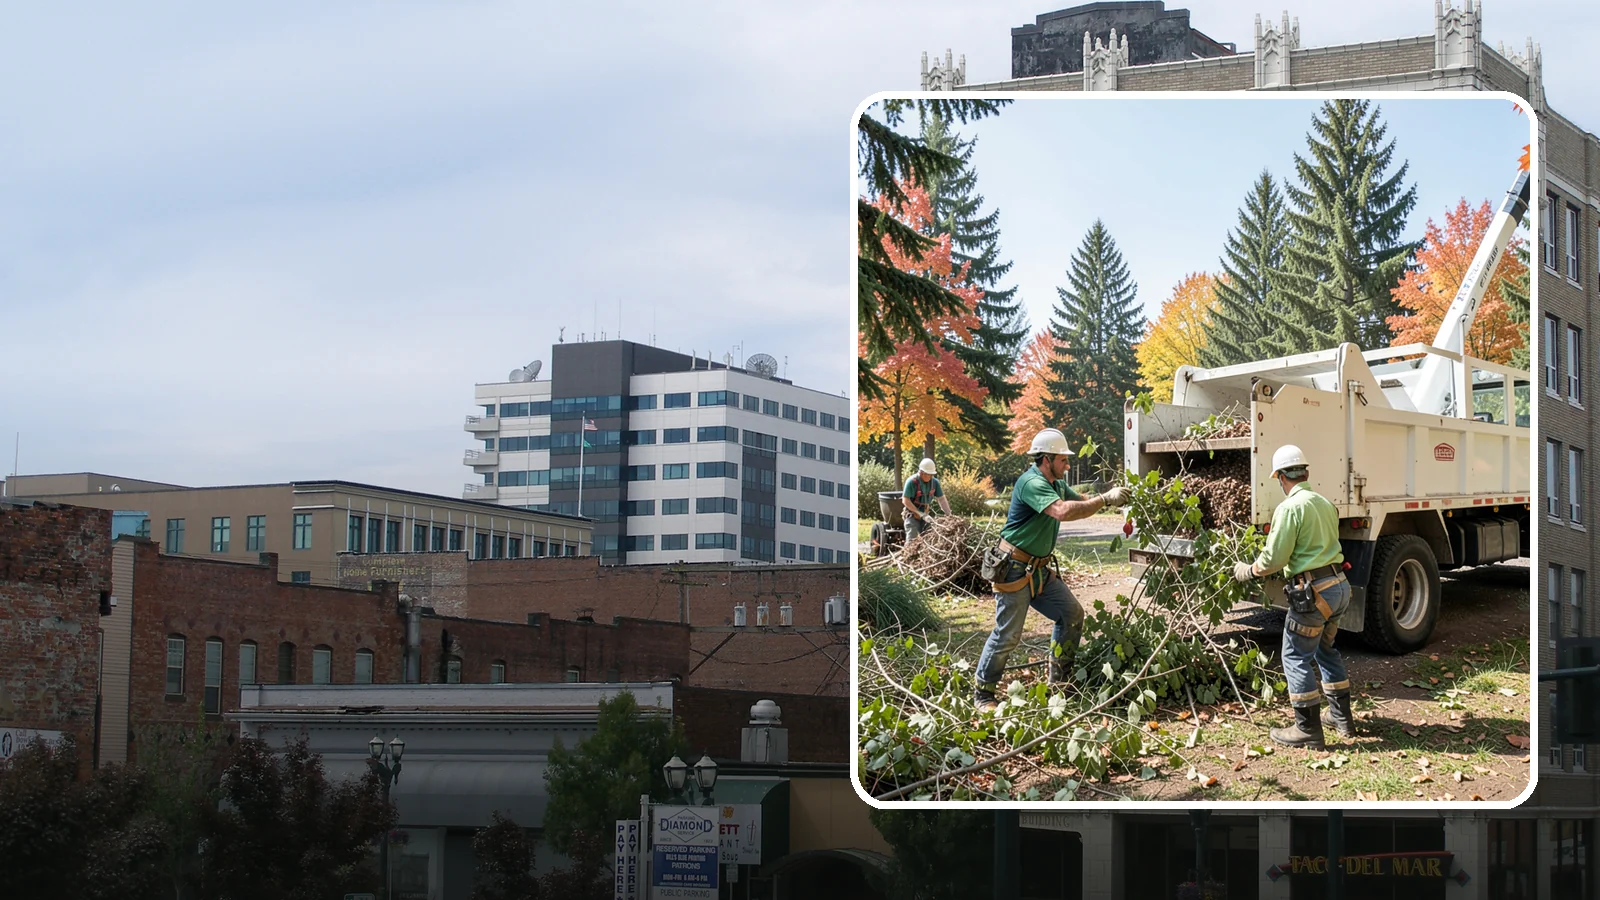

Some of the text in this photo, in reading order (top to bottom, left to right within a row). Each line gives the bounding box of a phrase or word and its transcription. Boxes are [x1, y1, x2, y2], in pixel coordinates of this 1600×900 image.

[343, 565, 427, 577] Home Furnishers
[660, 818, 713, 832] DIAMOND
[1021, 815, 1070, 828] BUILDING
[656, 845, 716, 854] RESERVED PARKING
[616, 825, 625, 893] PAY HERE
[627, 824, 637, 893] PAY HERE
[671, 862, 701, 870] PATRONS
[1346, 856, 1385, 876] DEL
[1392, 857, 1443, 877] MAR
[660, 888, 710, 899] PUBLIC PARKING
